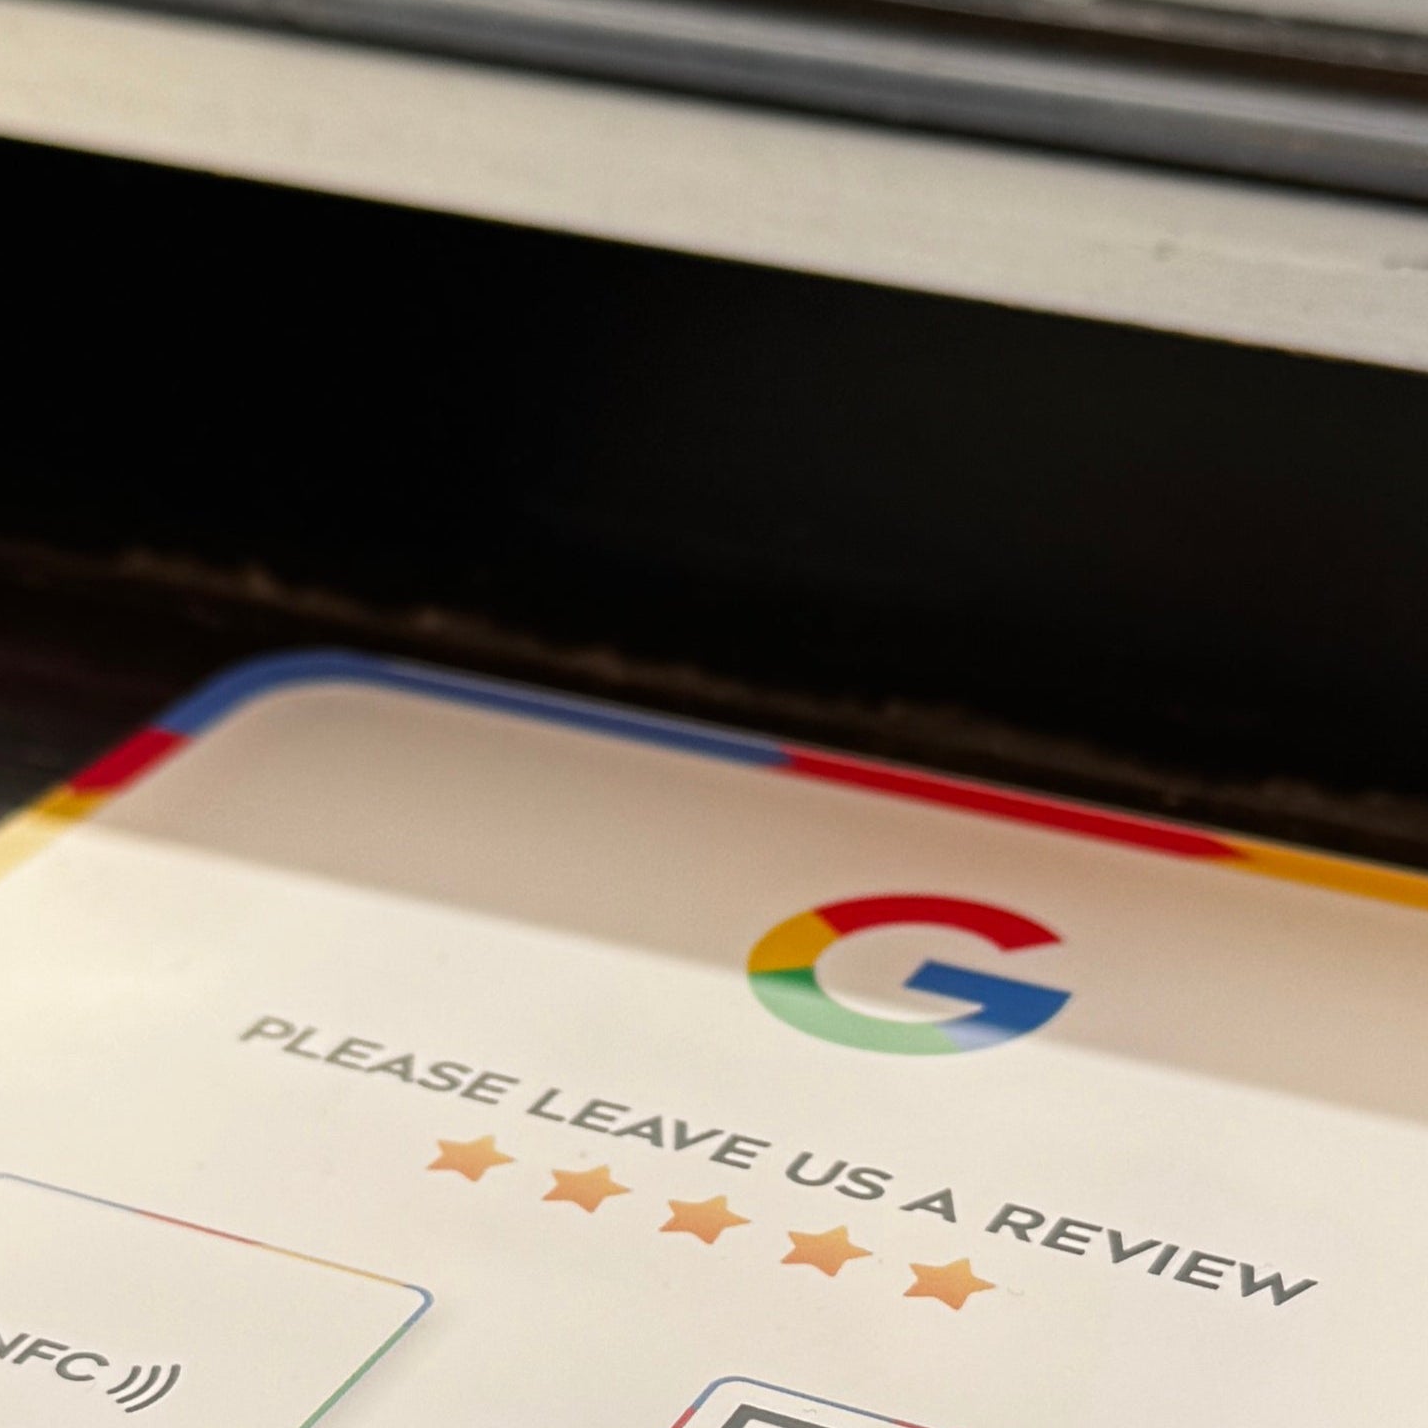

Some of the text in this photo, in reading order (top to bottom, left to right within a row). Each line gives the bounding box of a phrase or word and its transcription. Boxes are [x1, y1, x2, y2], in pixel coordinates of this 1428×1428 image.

[746, 894, 1073, 1056] G
[239, 1016, 1319, 1308] PLEASE LEAVE US A REVIEW
